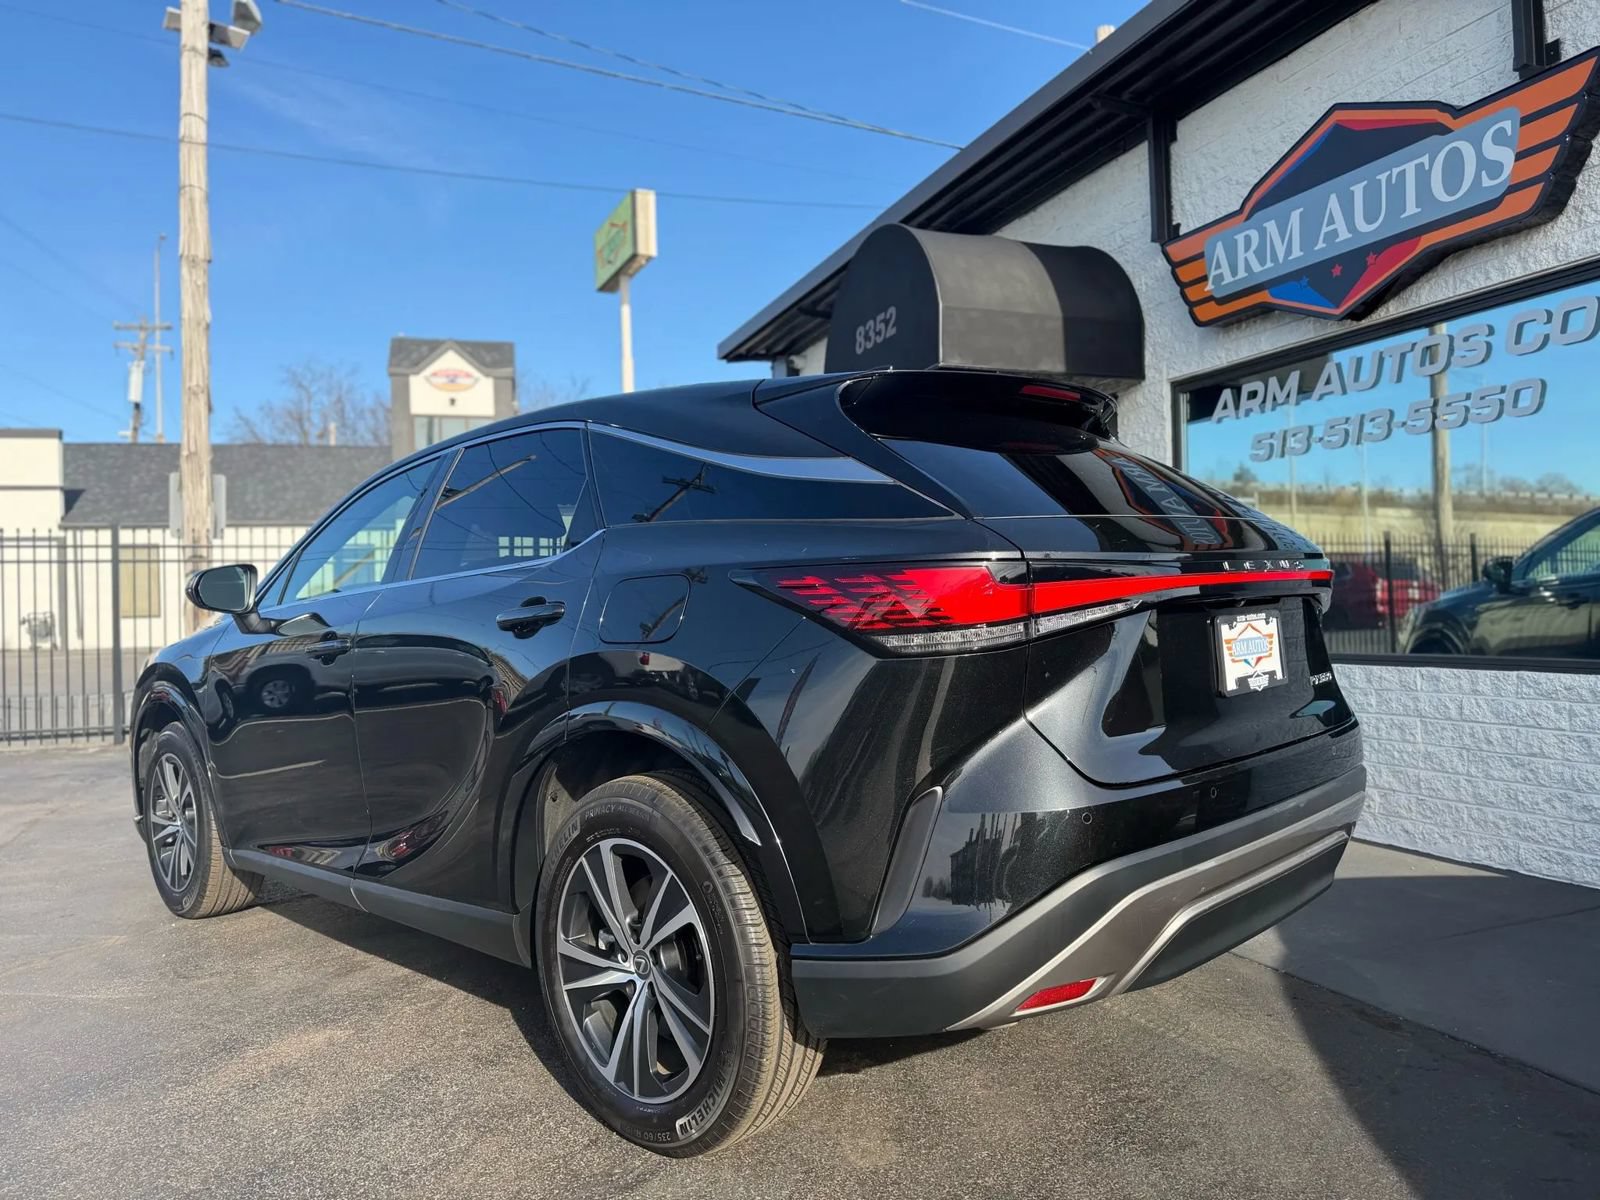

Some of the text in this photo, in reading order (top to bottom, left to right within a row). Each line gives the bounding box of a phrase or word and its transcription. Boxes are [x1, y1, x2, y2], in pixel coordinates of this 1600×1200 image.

[1204, 118, 1517, 292] ARM AUTOS
[855, 305, 897, 355] 8352
[1210, 369, 1311, 425] ARM
[1310, 322, 1493, 402] AUTOS
[1249, 377, 1547, 463] 513-513-5550
[1222, 559, 1304, 571] LEXUS
[1231, 636, 1270, 657] ARM AUTOS
[585, 804, 616, 821] PRIMACY
[679, 1066, 728, 1137] MICHELIN
[643, 1130, 671, 1142] 235/60
